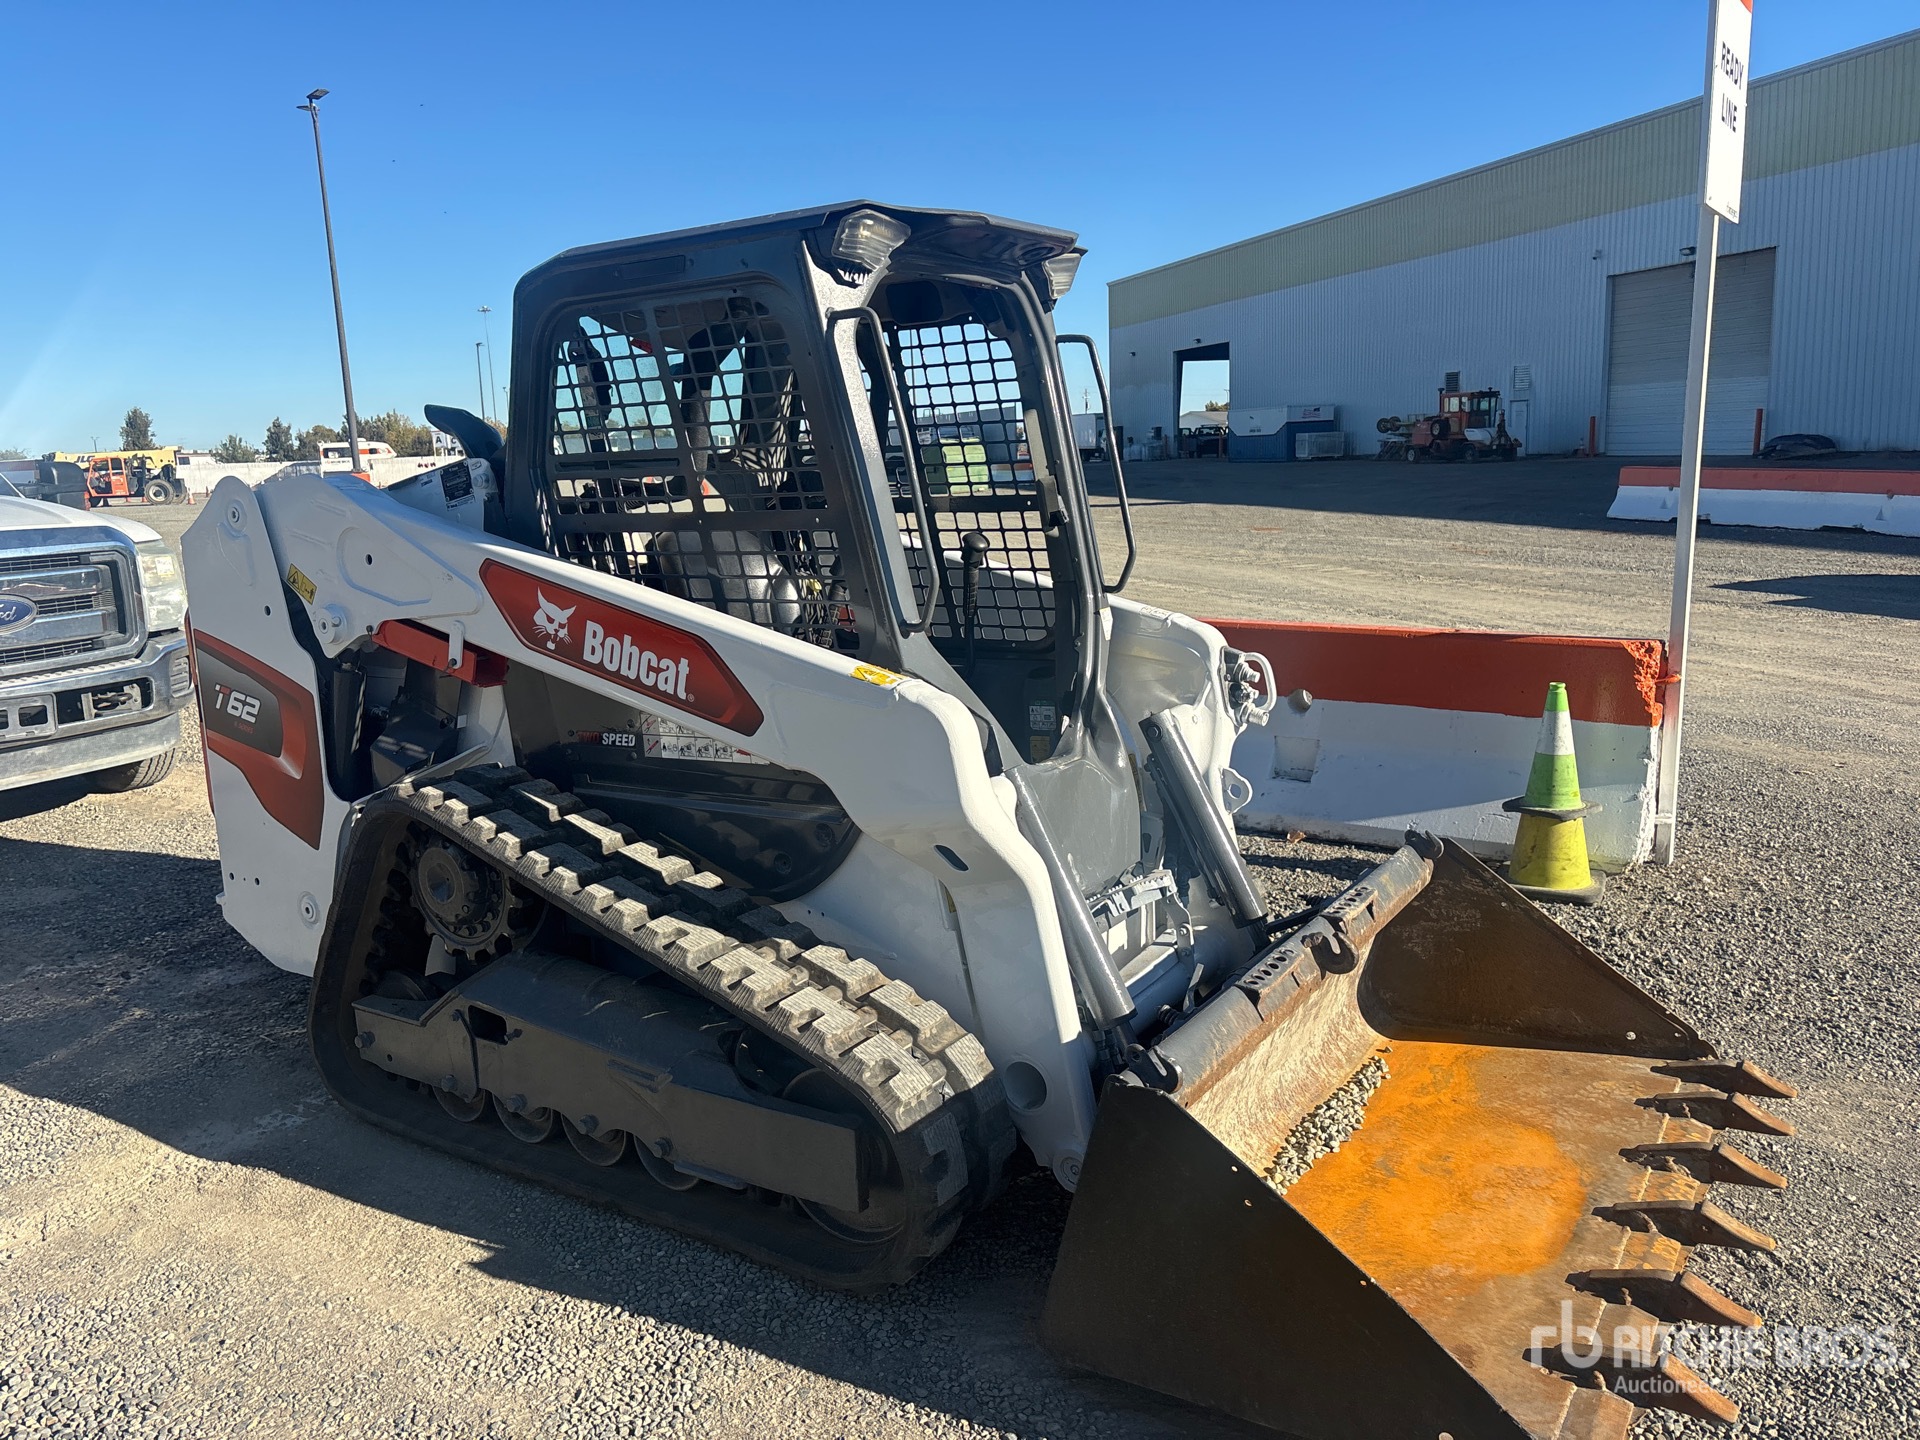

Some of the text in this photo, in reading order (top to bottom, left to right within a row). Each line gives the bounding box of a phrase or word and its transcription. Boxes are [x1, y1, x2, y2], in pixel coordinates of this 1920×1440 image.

[1721, 41, 1744, 90] READY
[1722, 93, 1737, 133] LINE
[436, 436, 442, 444] A
[583, 620, 690, 700] Bobcat
[215, 684, 261, 723] T62
[601, 733, 636, 747] SPEED
